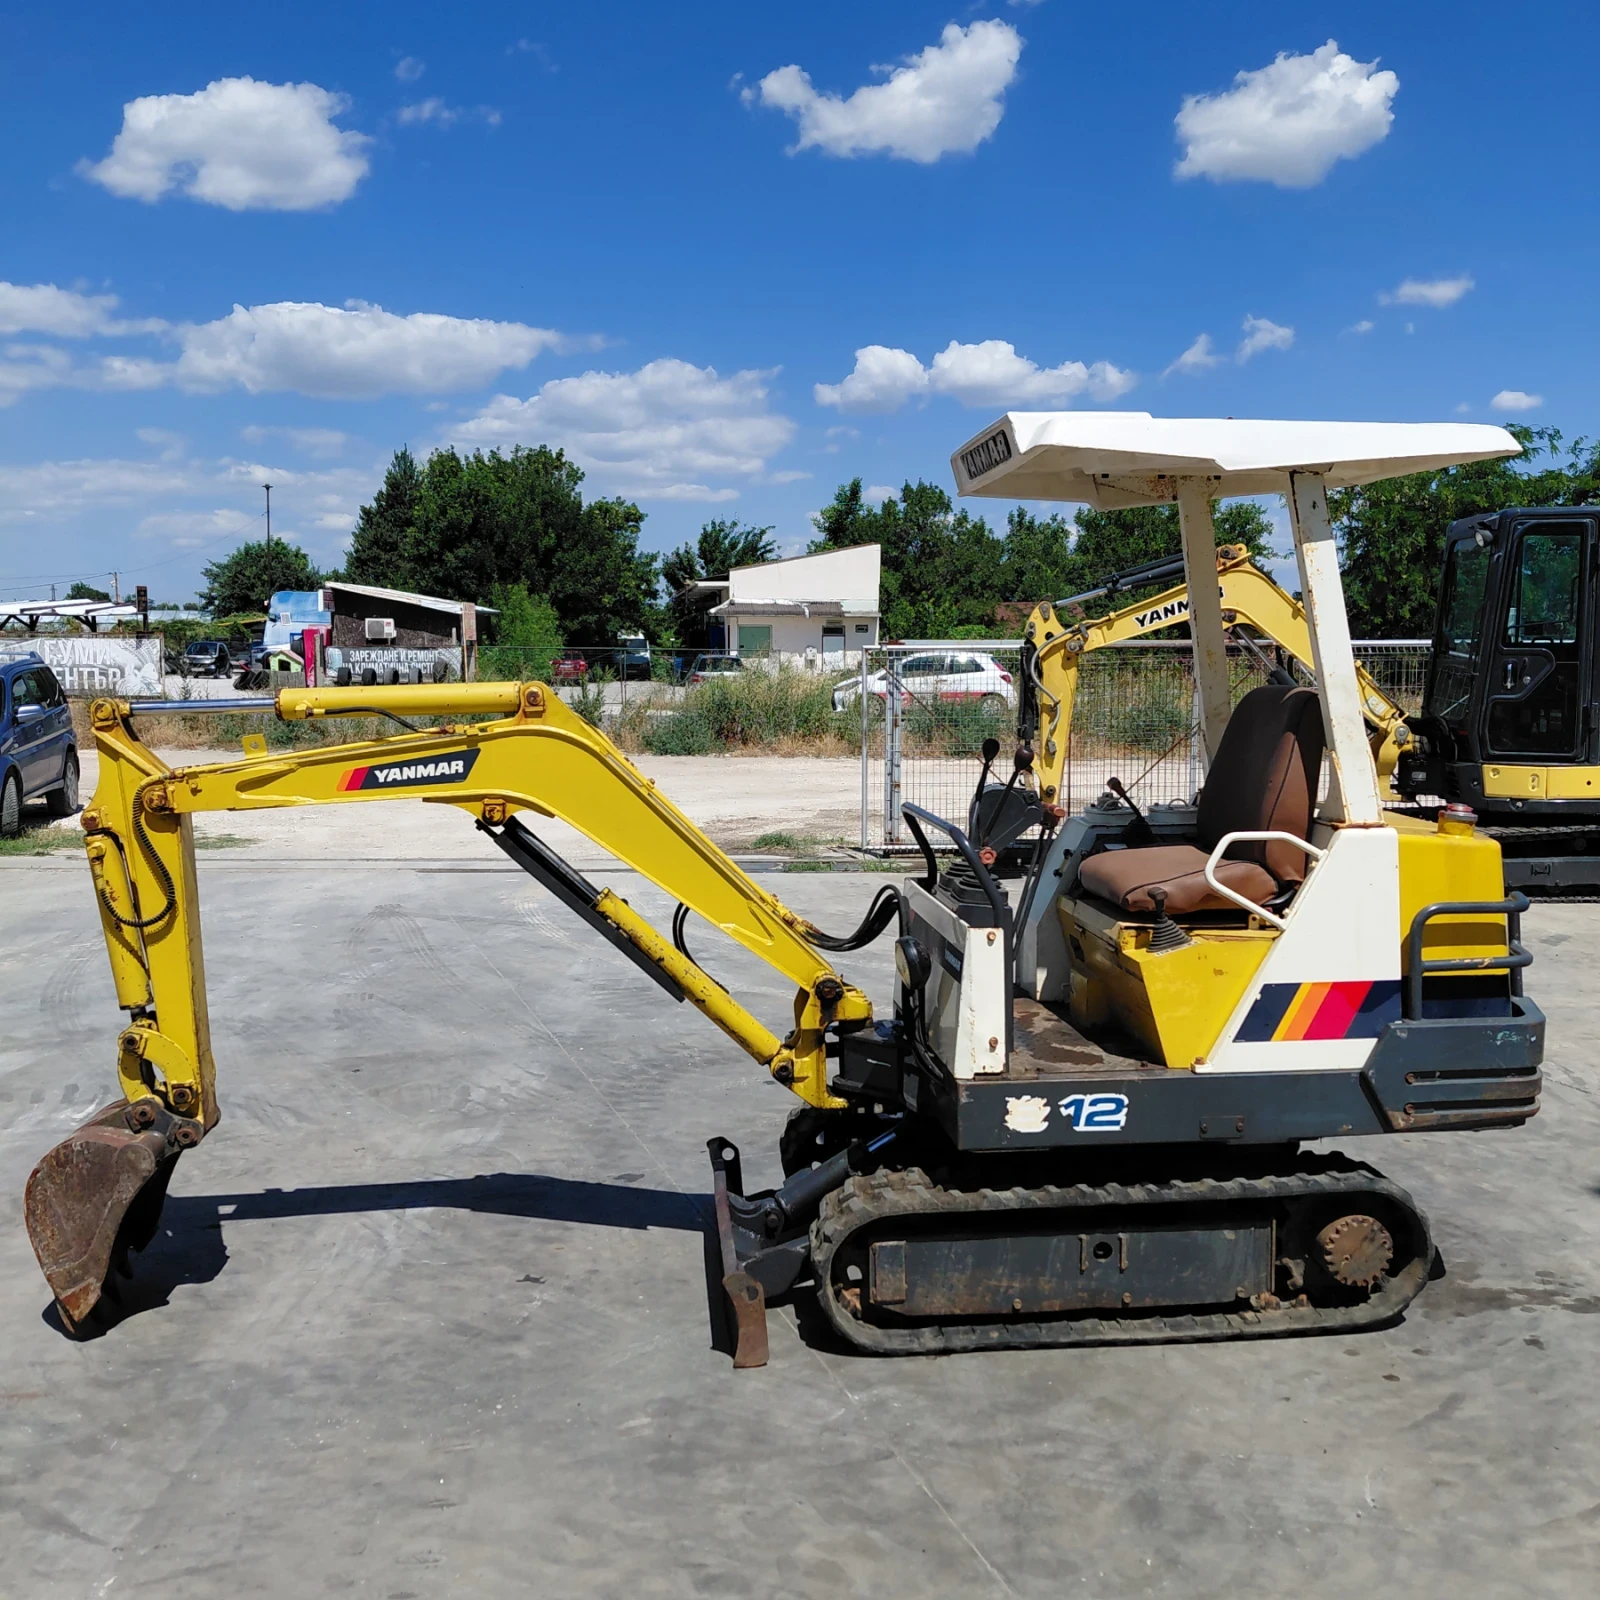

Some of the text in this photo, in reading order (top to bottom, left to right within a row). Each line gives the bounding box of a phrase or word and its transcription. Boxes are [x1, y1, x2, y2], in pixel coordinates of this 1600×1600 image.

[960, 431, 1008, 480] YANMAR
[44, 638, 112, 665] ГУМИ
[349, 650, 438, 663] ЗАРЕЖДАНЕ И РЕМОНТ
[54, 667, 121, 690] ЕНТЪР
[374, 760, 464, 783] YANMAR
[1061, 1095, 1127, 1129] 12
